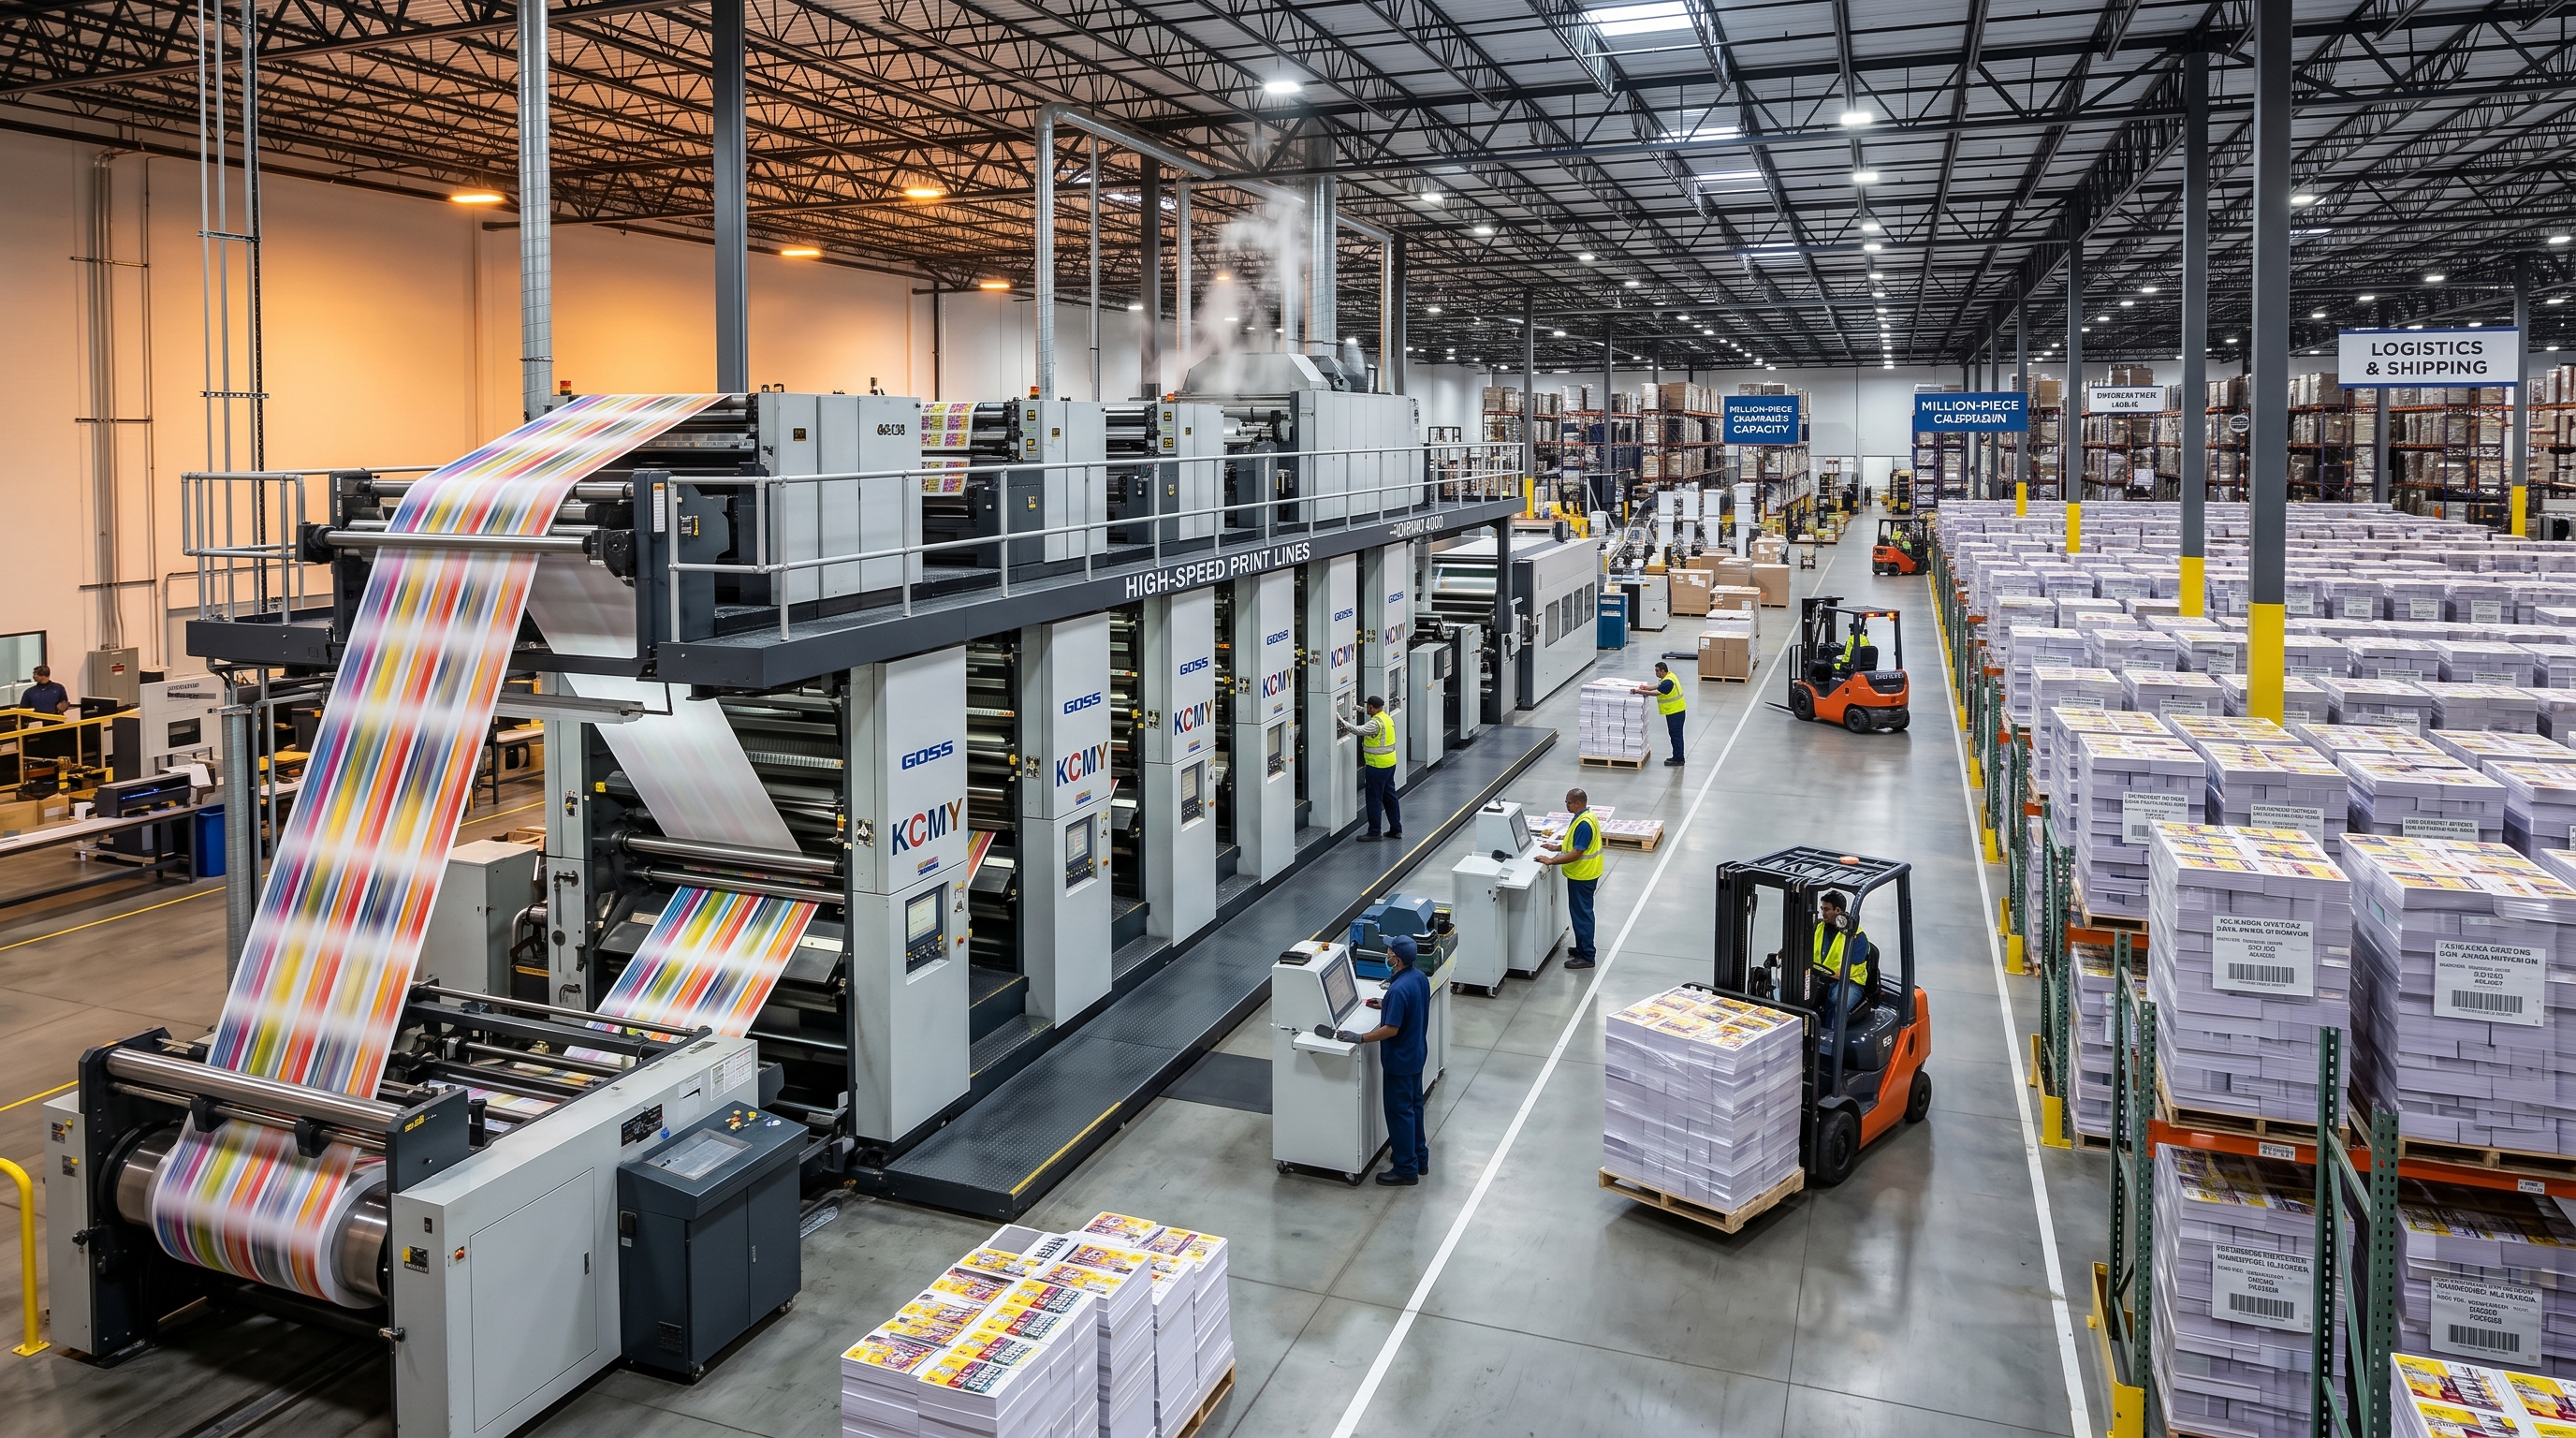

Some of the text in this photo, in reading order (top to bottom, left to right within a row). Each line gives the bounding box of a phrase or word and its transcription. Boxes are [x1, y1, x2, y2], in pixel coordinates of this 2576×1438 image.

[2371, 340, 2483, 357] LOGISTICS
[2365, 360, 2488, 375] & SHIPPING
[1922, 400, 2019, 411] MILLION-PIECE
[1733, 424, 1790, 433] CAPACITY
[1426, 515, 1443, 531] 4000
[1125, 541, 1310, 599] HIGH-SPEED PRINT LINES
[1179, 656, 1208, 676] GOSS
[1263, 667, 1294, 699] KCMY
[1063, 691, 1102, 715] GOSS
[1174, 698, 1213, 737] KCMY
[901, 740, 954, 770] GOSS
[1056, 741, 1108, 788] KCMY
[892, 797, 963, 857] KCMY
